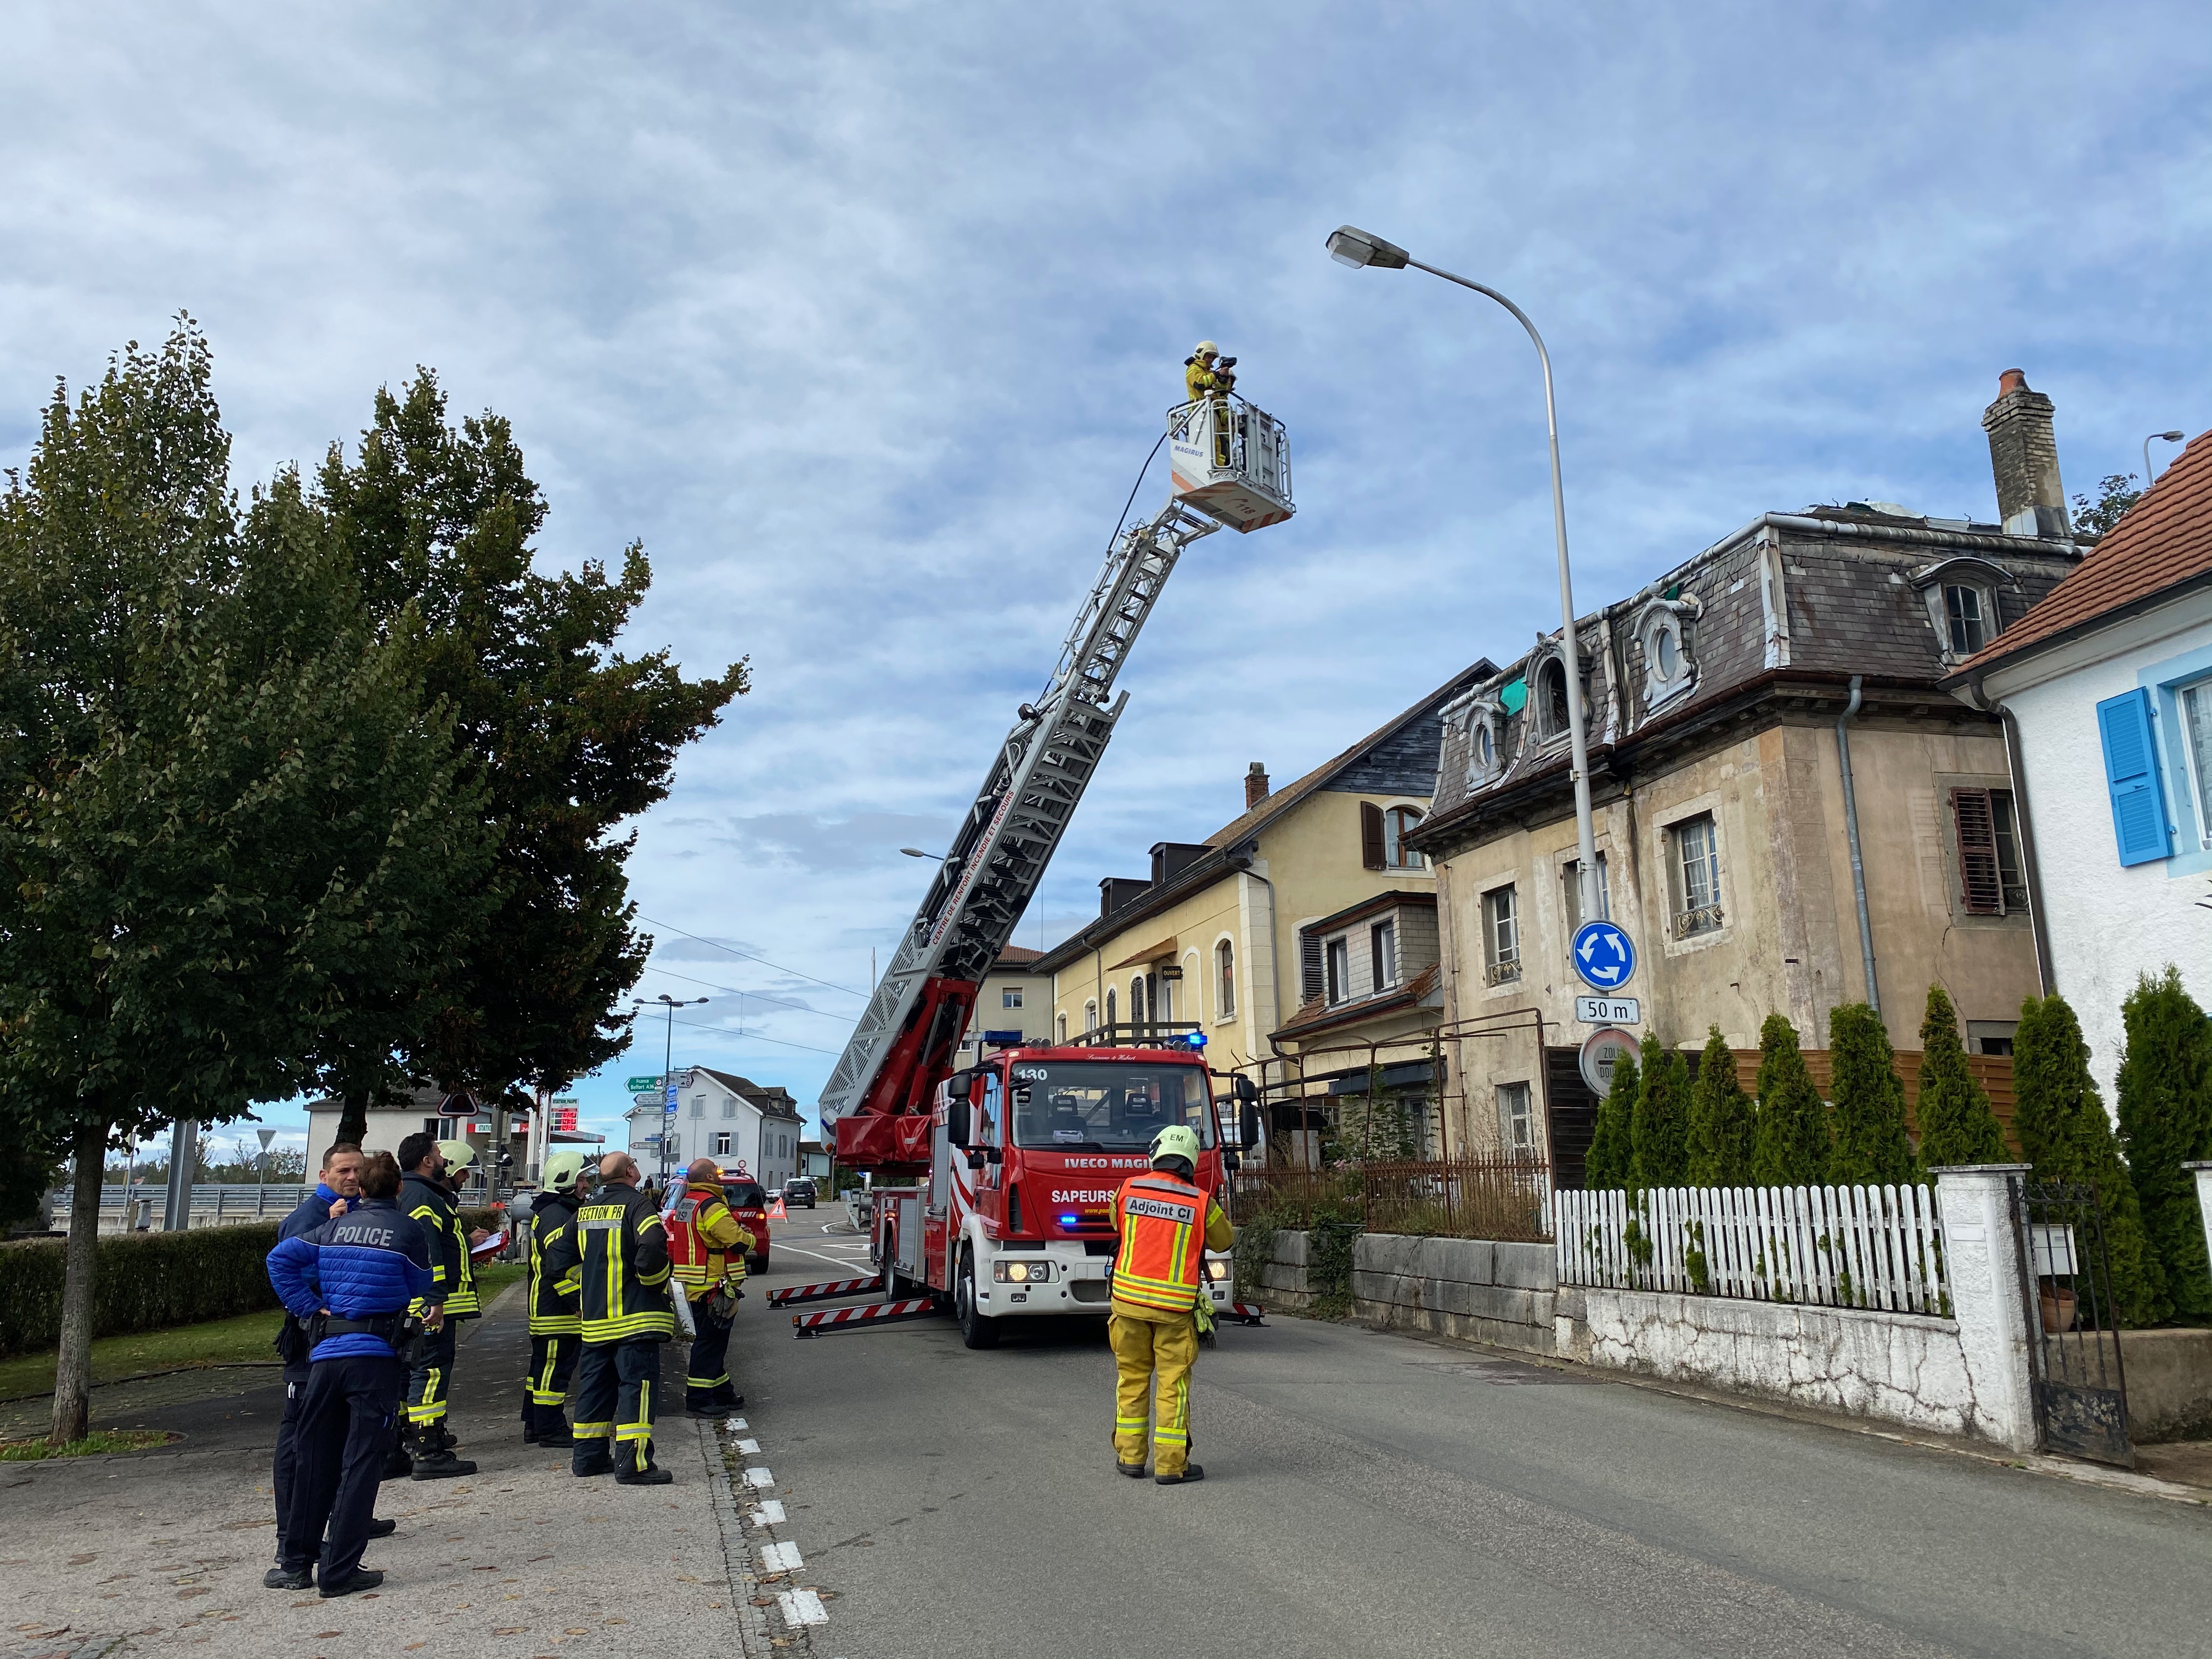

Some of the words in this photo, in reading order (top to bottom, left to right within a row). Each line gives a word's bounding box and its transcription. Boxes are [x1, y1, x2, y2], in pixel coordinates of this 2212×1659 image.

[1174, 445, 1204, 457] MAGIRUS
[1235, 503, 1256, 515] 118
[933, 916, 950, 945] CENTRE
[947, 905, 955, 916] DE
[953, 870, 973, 905] RENFORT
[970, 836, 991, 871] INCENDIE
[988, 825, 996, 836] ET
[994, 790, 1014, 825] SECOURS
[1588, 1001, 1607, 1018] 50
[1614, 1006, 1628, 1019] m
[1604, 1047, 1618, 1059] ZOL
[1018, 1069, 1048, 1081] 130
[1170, 1134, 1184, 1142] EM
[1065, 1158, 1108, 1168] IVECO
[578, 1206, 610, 1221] SECTION
[611, 1206, 623, 1219] PR
[1129, 1199, 1173, 1216] Adjoint
[1178, 1207, 1190, 1220] CI
[333, 1226, 394, 1246] POLICE
